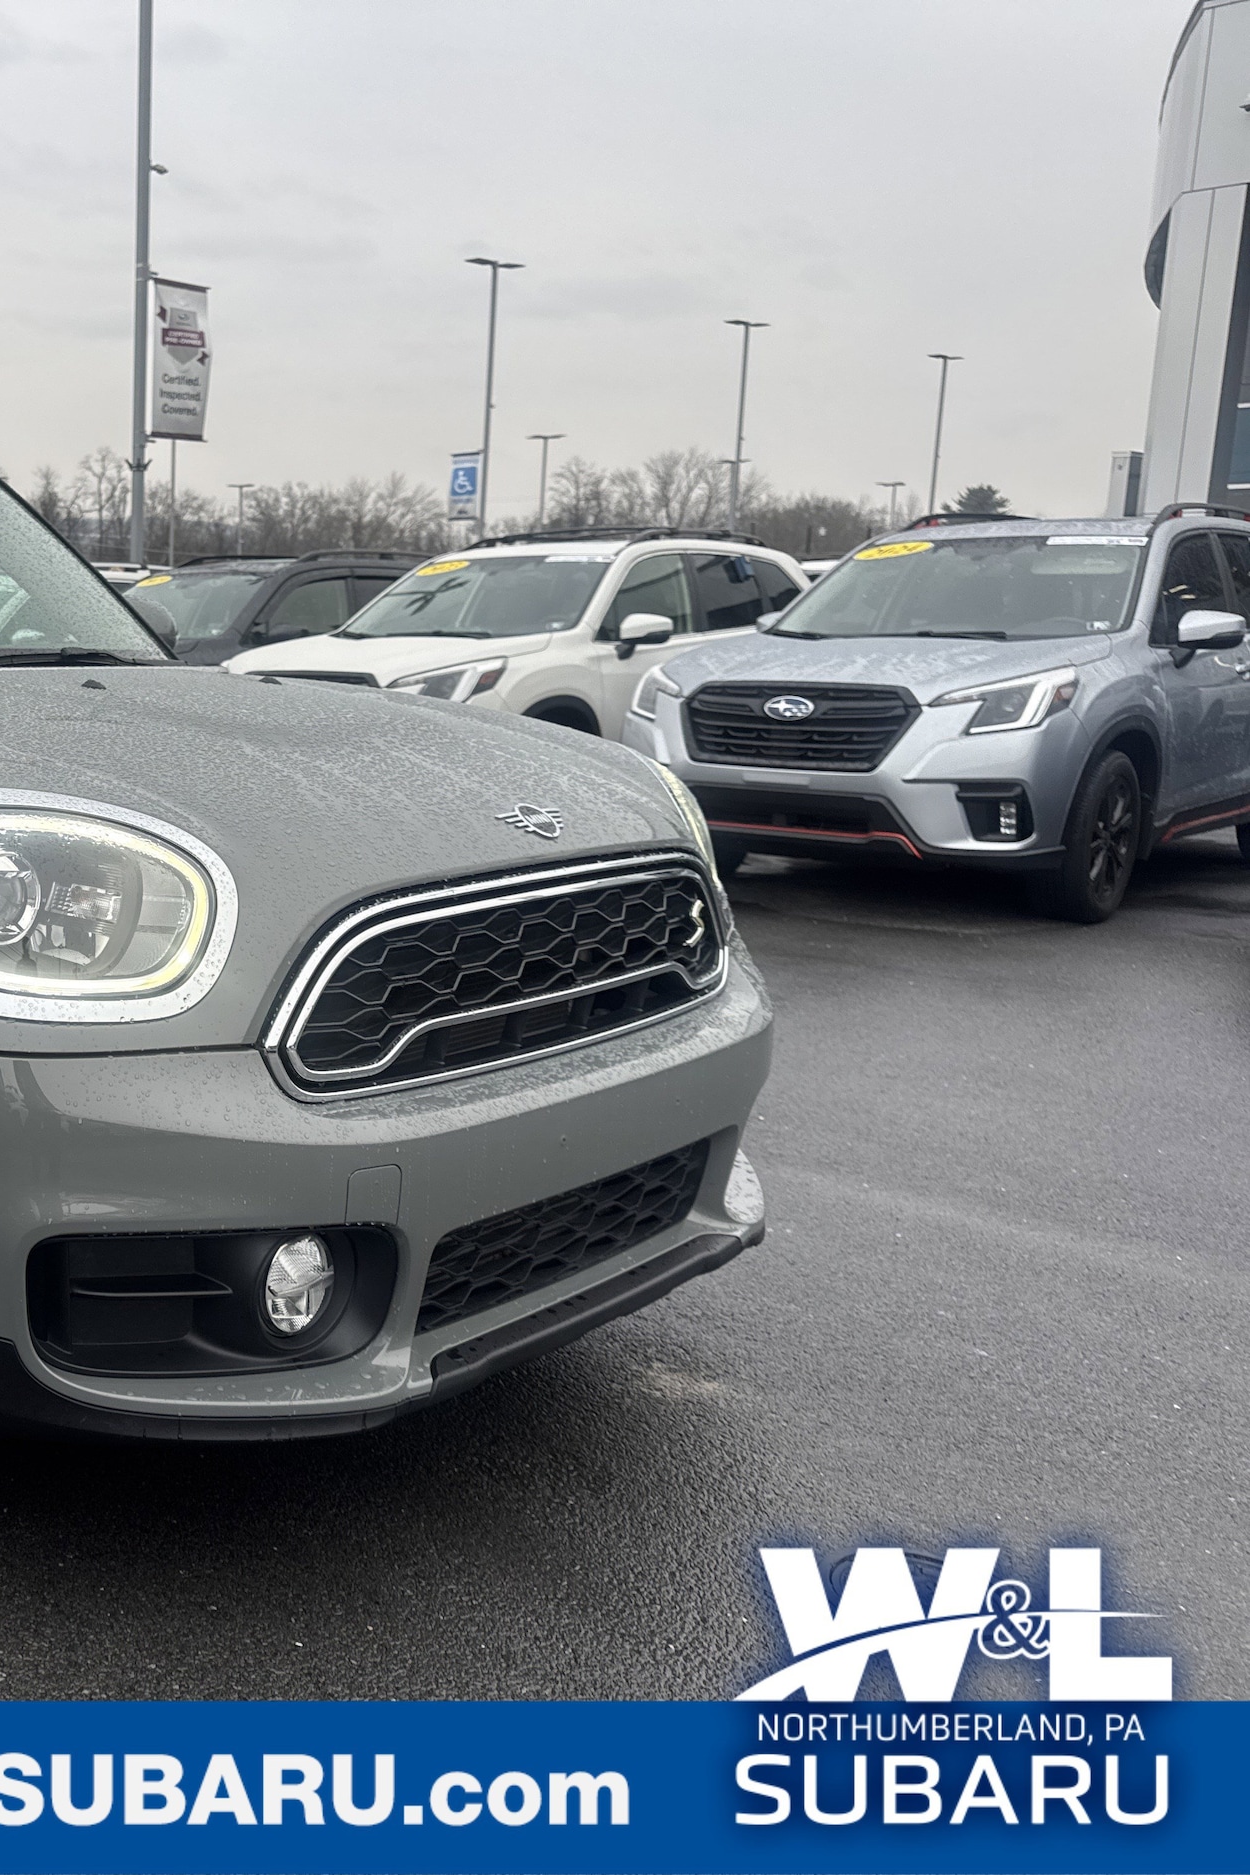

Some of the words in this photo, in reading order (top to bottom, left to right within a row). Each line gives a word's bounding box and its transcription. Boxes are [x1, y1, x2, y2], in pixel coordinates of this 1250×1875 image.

[161, 373, 202, 387] Certified.
[159, 388, 203, 402] Inspected.
[161, 403, 199, 416] Covered.
